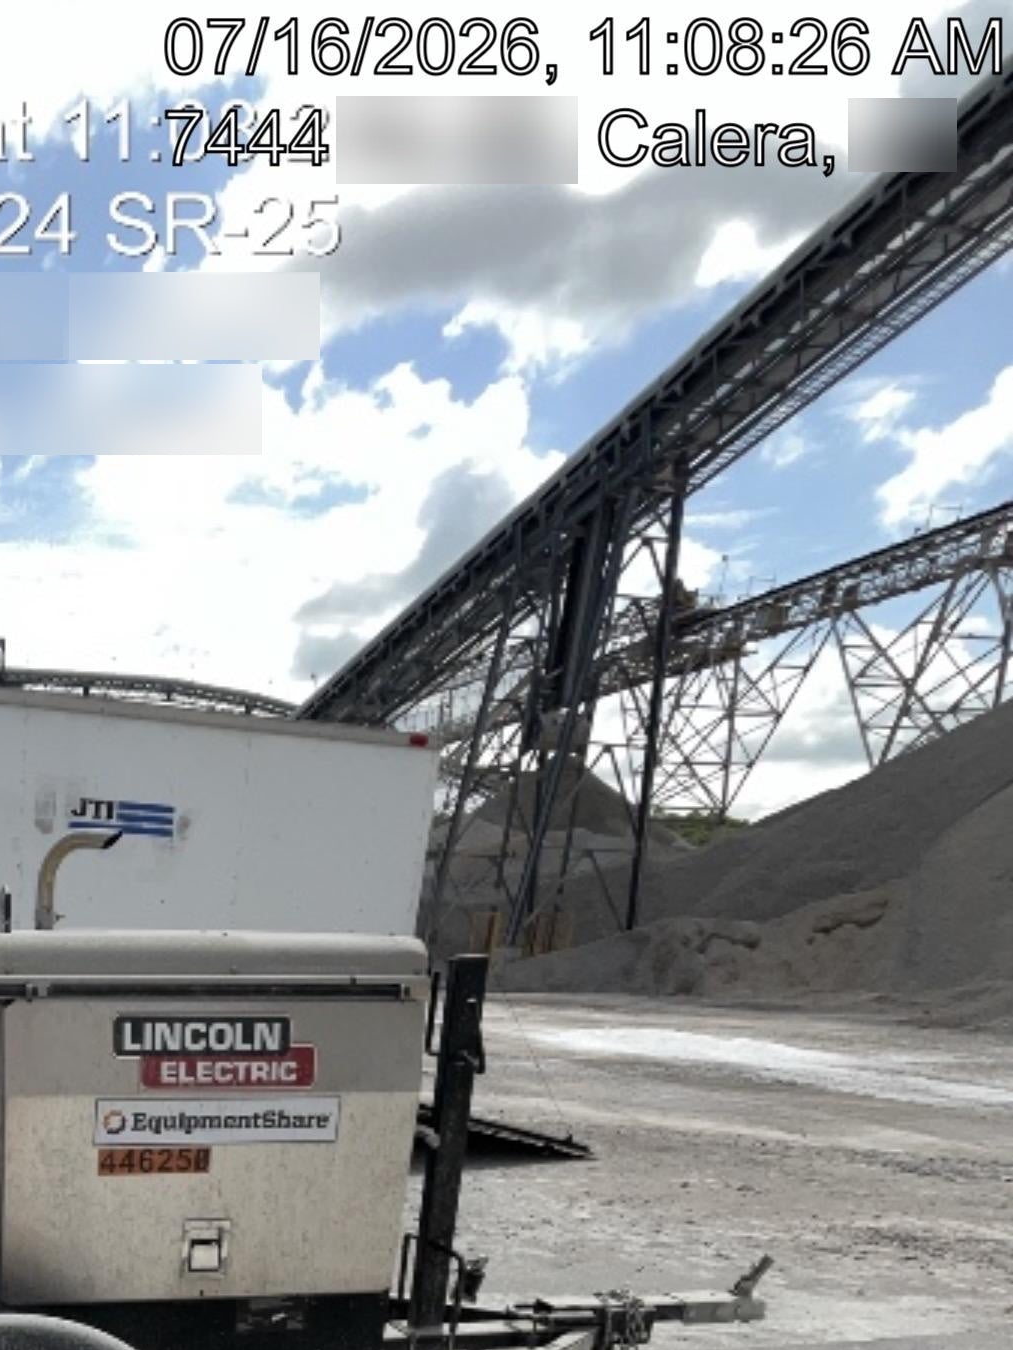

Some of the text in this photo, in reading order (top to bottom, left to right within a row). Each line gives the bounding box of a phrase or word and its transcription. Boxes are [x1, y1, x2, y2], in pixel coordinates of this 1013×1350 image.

[70, 797, 115, 820] JTI
[121, 1021, 282, 1051] LINCOLN
[159, 1060, 298, 1084] ELECTRIC
[131, 1108, 330, 1135] EquipmentShare
